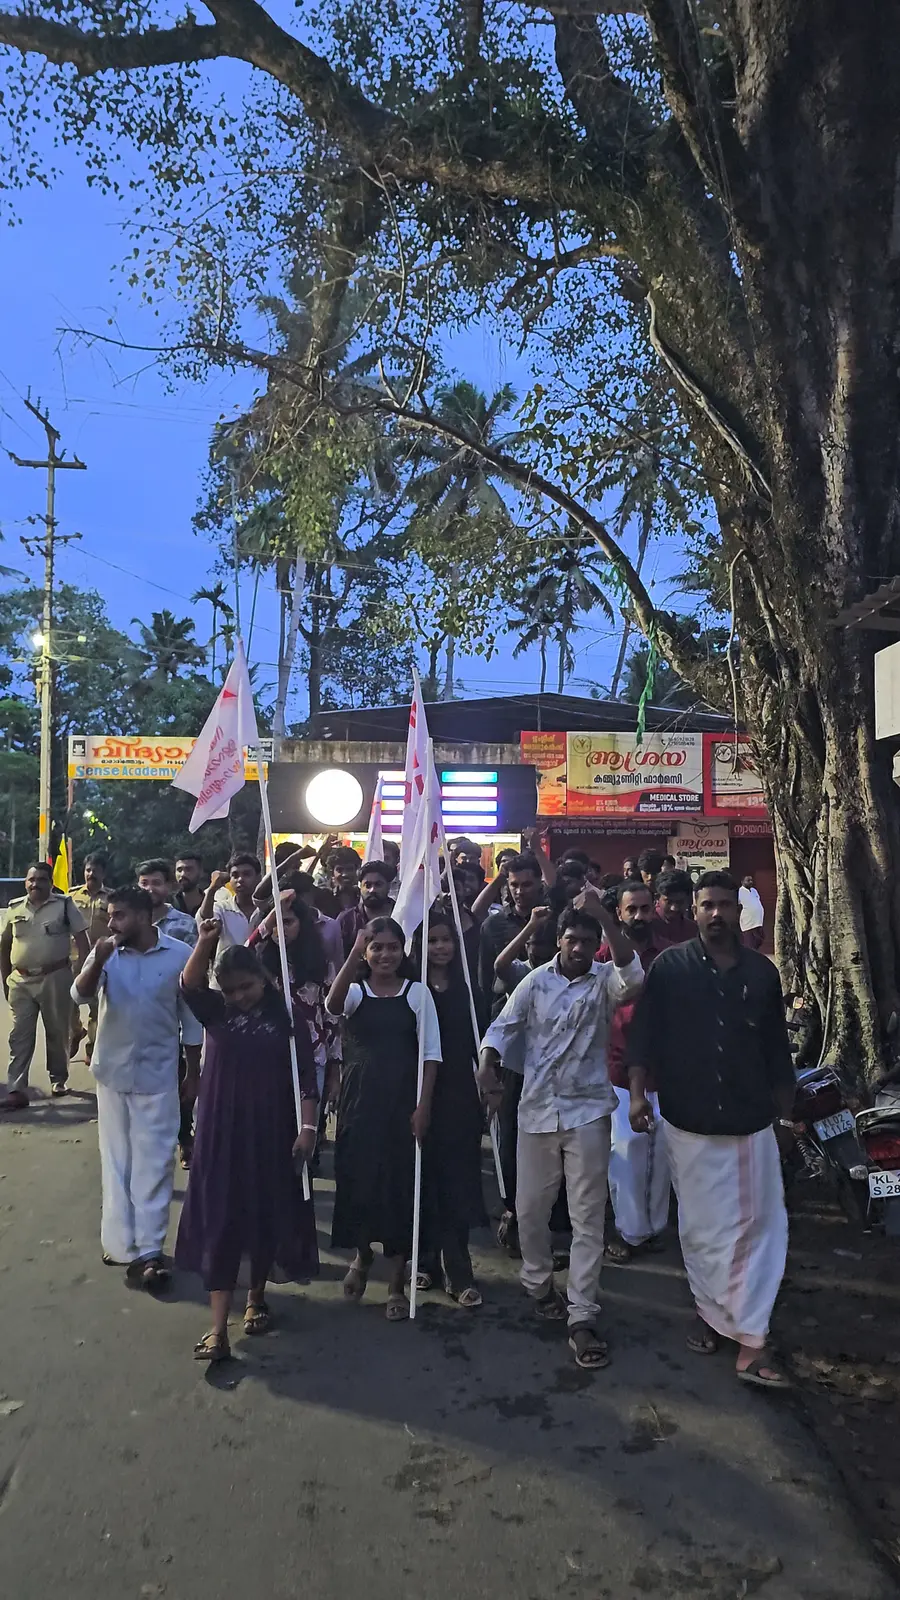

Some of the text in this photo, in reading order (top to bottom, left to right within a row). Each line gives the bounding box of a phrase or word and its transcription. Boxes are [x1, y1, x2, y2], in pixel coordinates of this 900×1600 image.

[586, 750, 687, 772] ആശ്രയ
[76, 766, 178, 778] Sense Academy
[650, 794, 699, 802] MEDICAL STORE
[876, 1175, 893, 1184] KL
[874, 1186, 881, 1195] S
